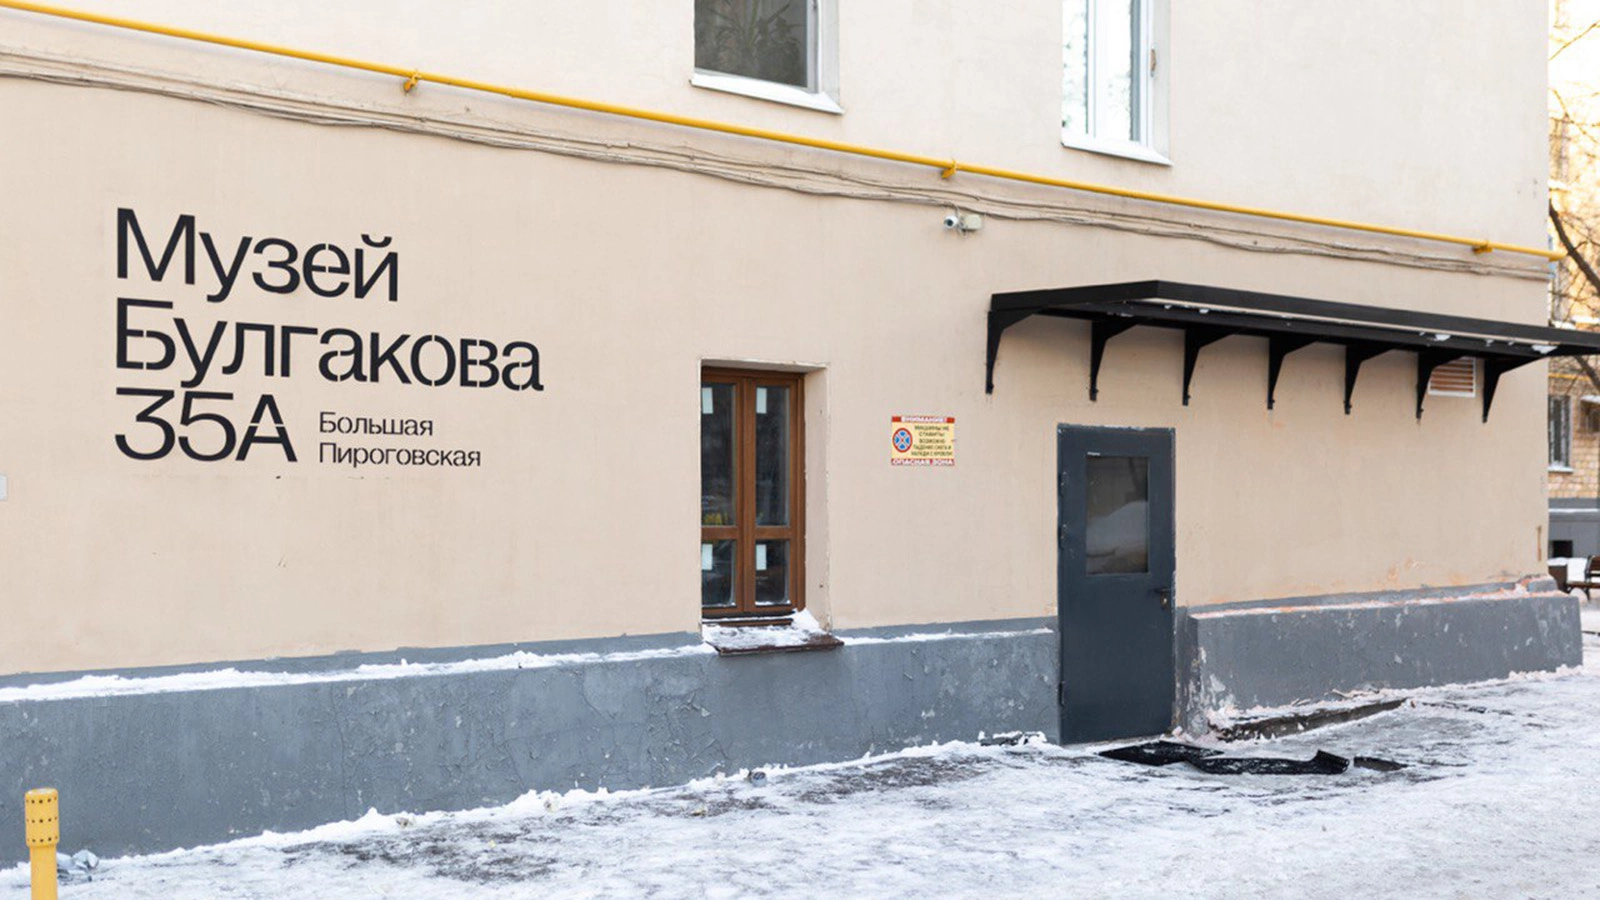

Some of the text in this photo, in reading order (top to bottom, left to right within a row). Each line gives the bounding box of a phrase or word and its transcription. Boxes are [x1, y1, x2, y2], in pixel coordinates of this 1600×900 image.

[117, 207, 399, 302] Музей
[116, 297, 545, 392] Булгакова
[114, 387, 298, 463] 35А
[319, 411, 433, 436] Большая
[319, 442, 481, 468] Пироговская
